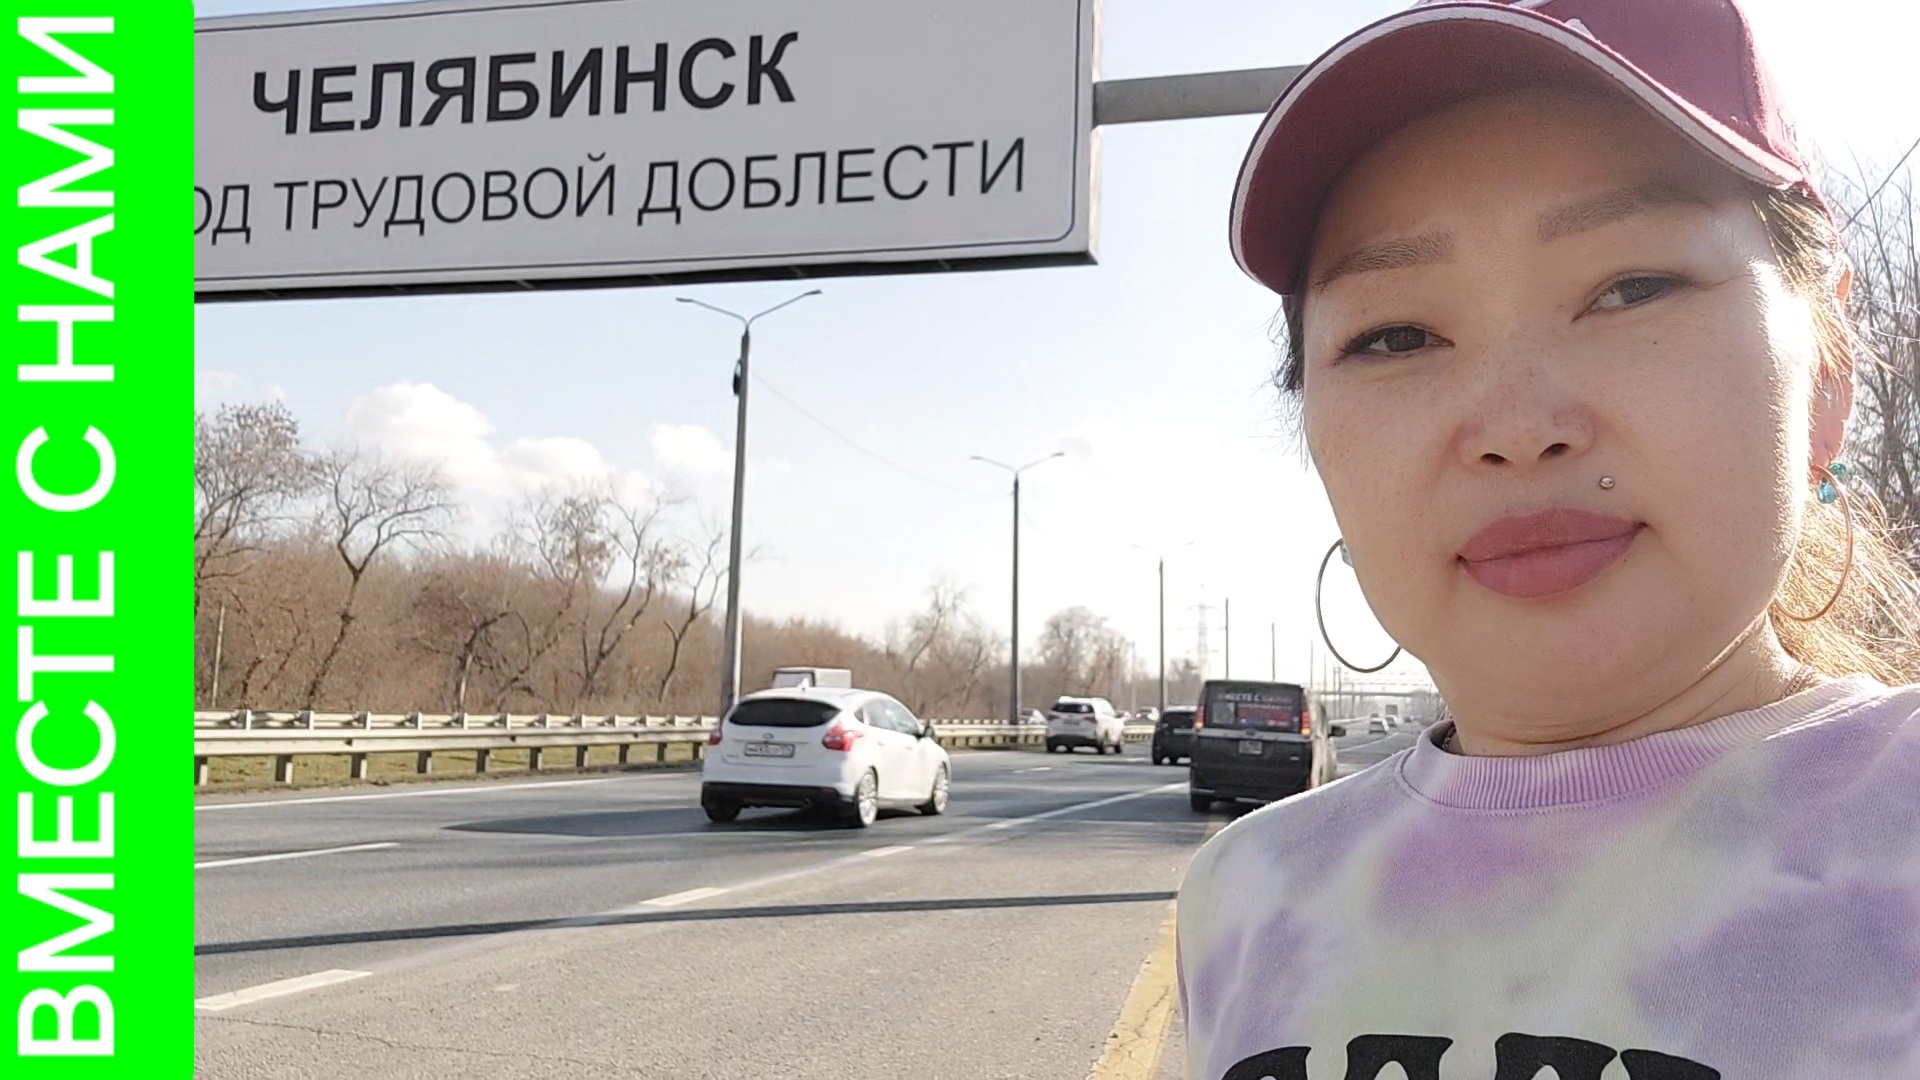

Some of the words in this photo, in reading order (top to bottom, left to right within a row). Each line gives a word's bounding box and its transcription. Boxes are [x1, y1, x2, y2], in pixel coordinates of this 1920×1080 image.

[252, 31, 799, 136] ЧЕЛЯБИНСК
[273, 151, 616, 238] ТРУДОВОЙ
[636, 137, 1025, 227] ДОБЛЕСТИ
